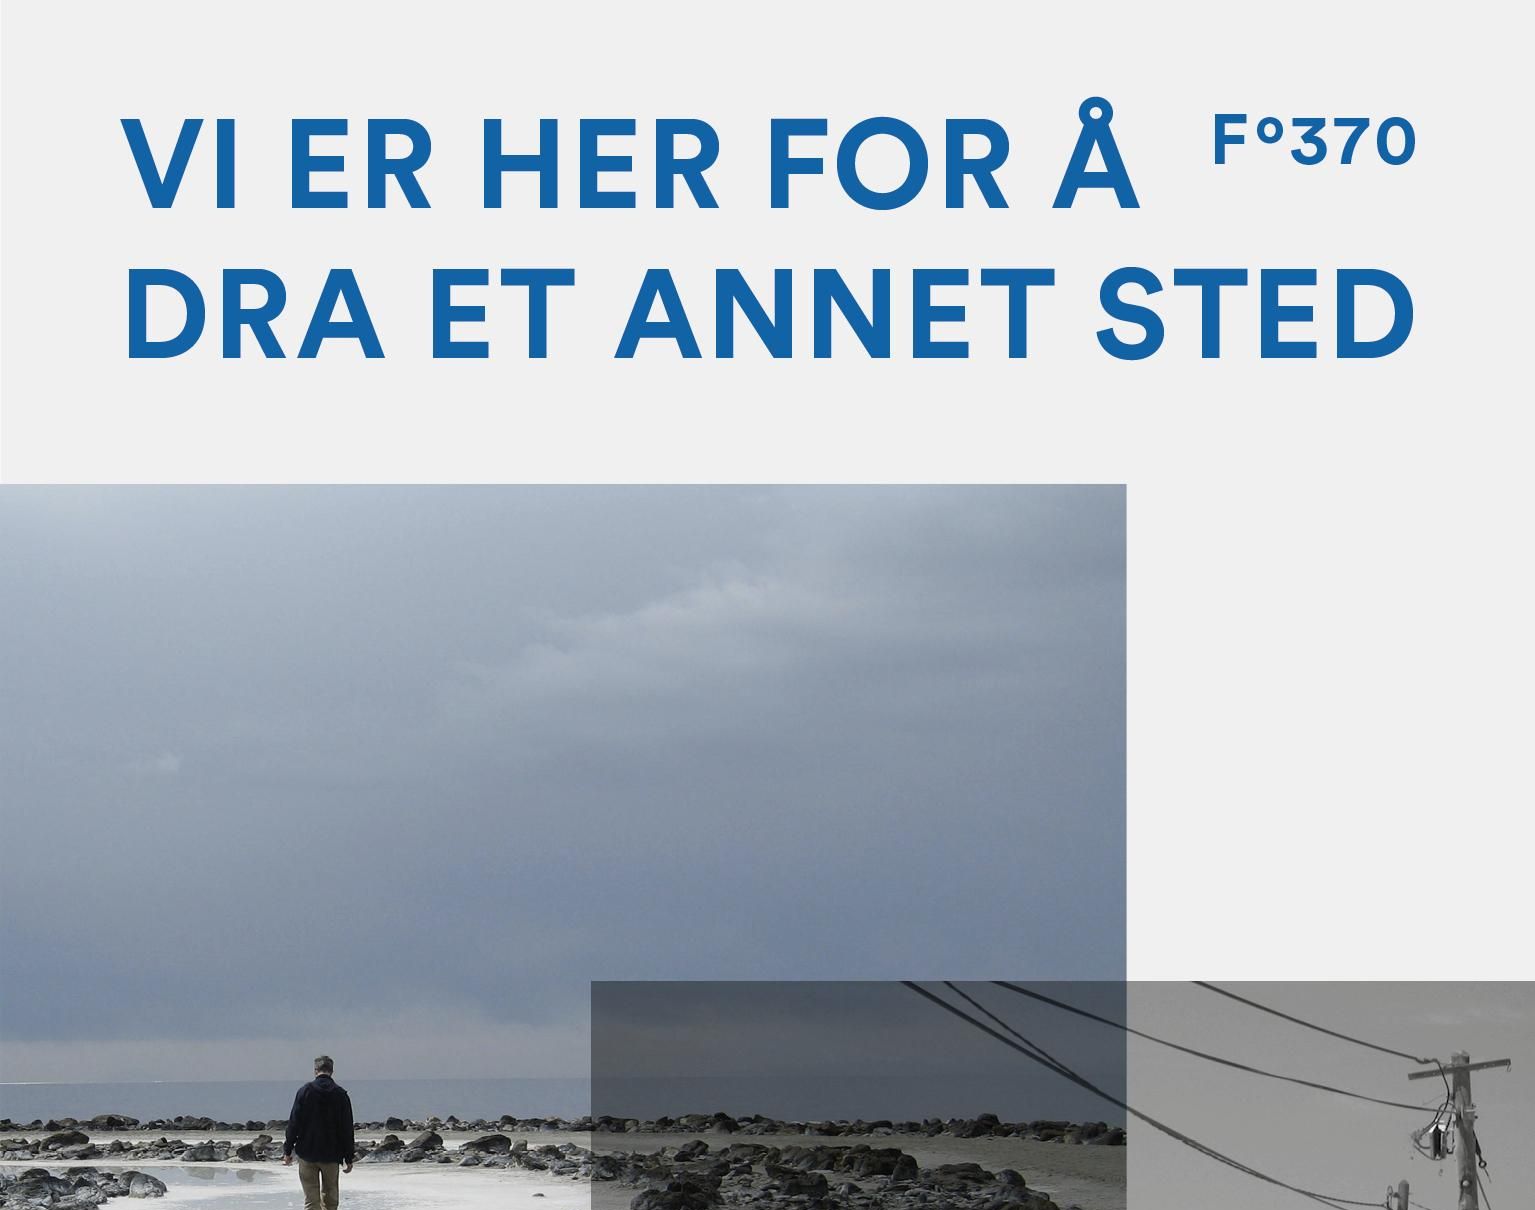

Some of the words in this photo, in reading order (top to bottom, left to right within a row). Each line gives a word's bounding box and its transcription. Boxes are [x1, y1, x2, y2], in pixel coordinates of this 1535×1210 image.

[121, 119, 236, 209] VI
[291, 119, 432, 209] ER
[483, 119, 720, 209] HER
[770, 117, 1010, 210] FOR
[1052, 97, 1141, 209] Å
[128, 268, 384, 359] DRA
[432, 268, 576, 359] ET
[615, 268, 1056, 359] ANNET
[1096, 266, 1414, 361] STED
